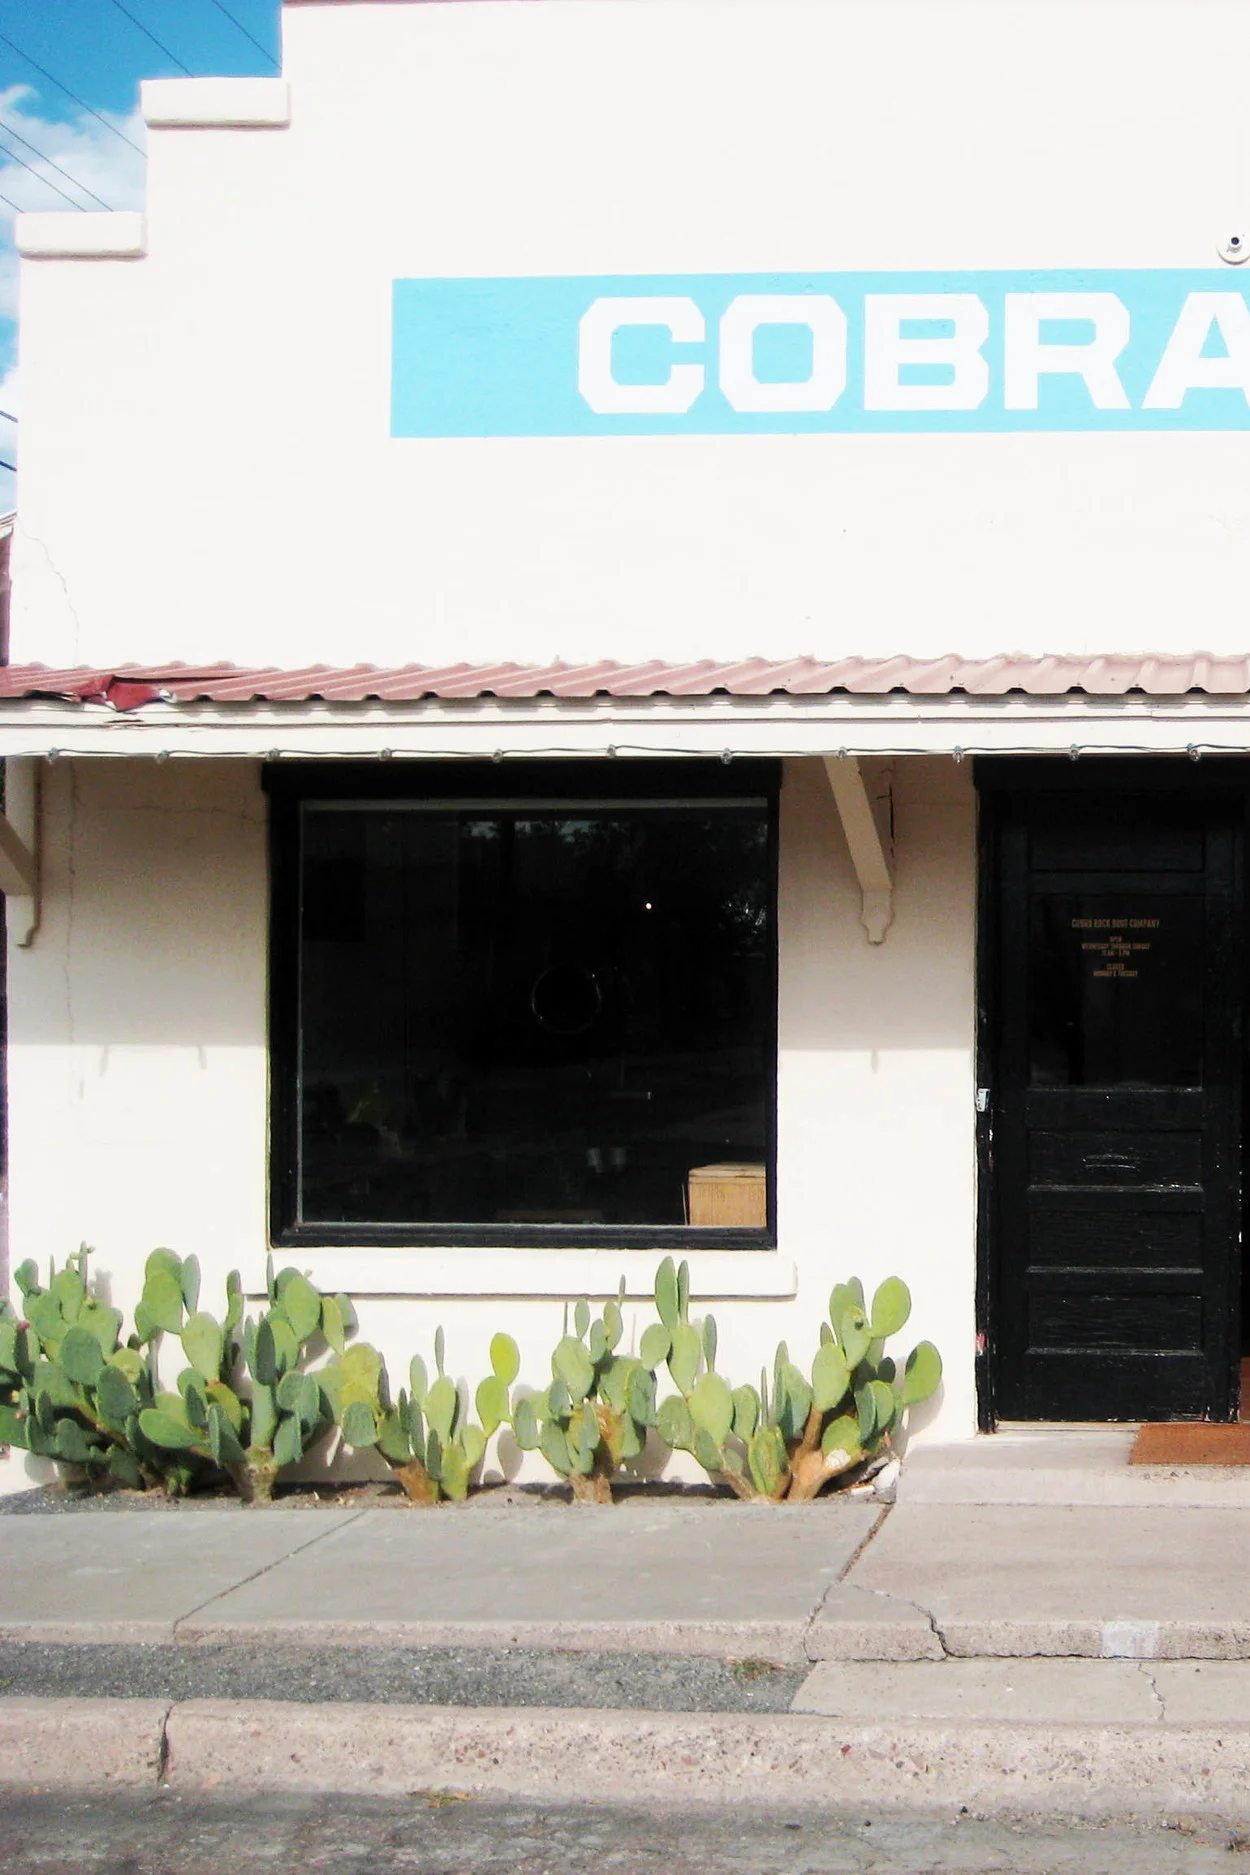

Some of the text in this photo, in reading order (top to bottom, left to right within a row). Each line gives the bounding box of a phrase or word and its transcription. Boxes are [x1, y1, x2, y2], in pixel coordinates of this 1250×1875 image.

[1071, 918, 1093, 928] COBRA
[1094, 918, 1111, 928] ROCK
[1129, 918, 1161, 928] COMPANY
